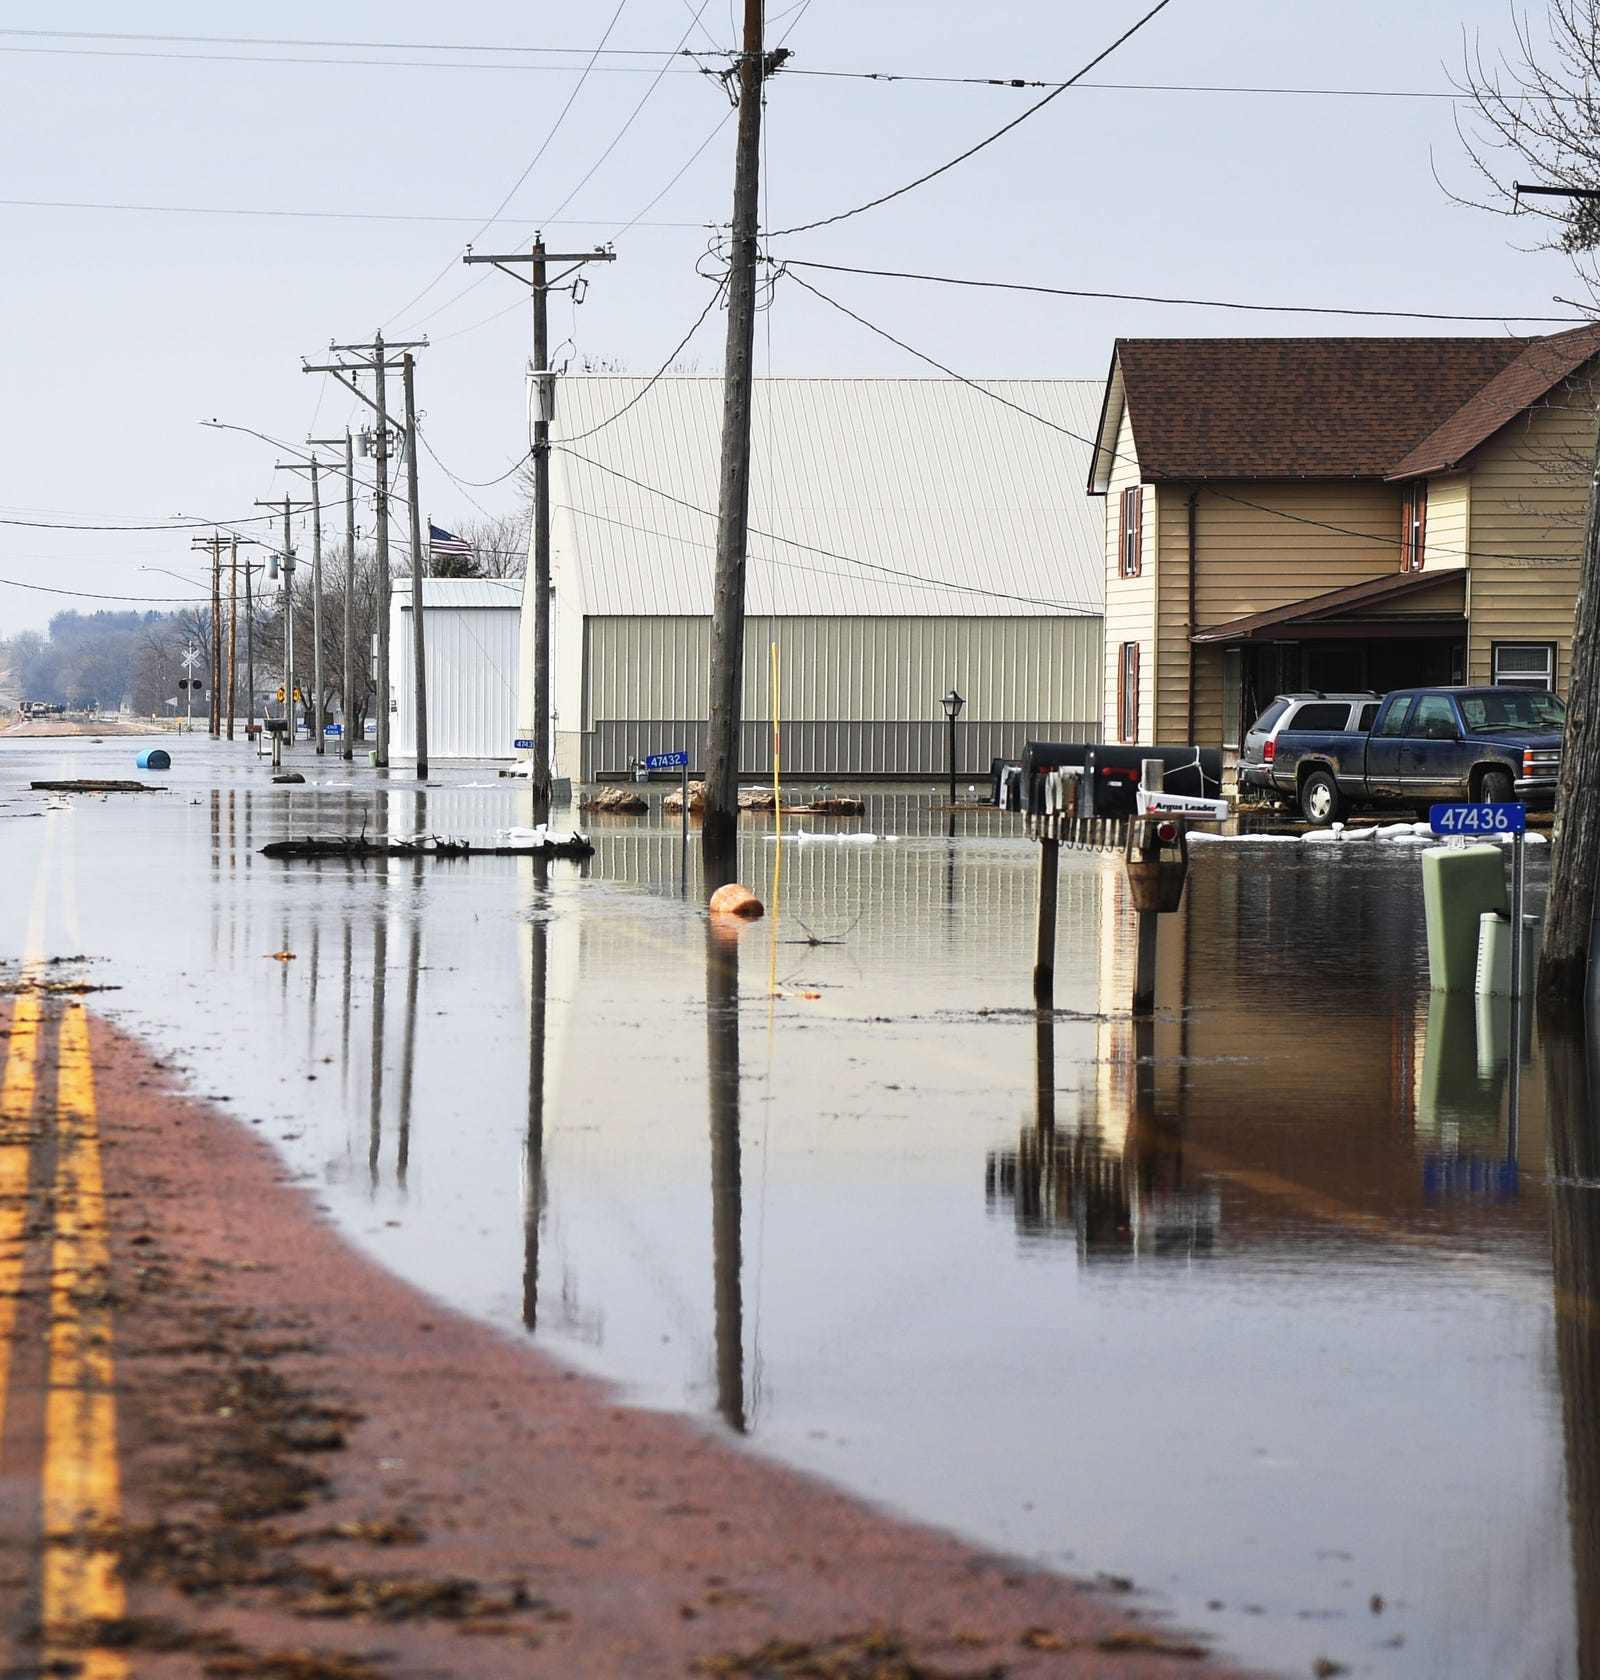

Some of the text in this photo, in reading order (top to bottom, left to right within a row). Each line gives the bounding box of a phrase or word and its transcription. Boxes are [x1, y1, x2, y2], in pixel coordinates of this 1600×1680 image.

[516, 740, 533, 748] 4743
[650, 754, 682, 768] 47432
[1155, 802, 1217, 812] Argus Leader
[1440, 808, 1509, 830] 47436
